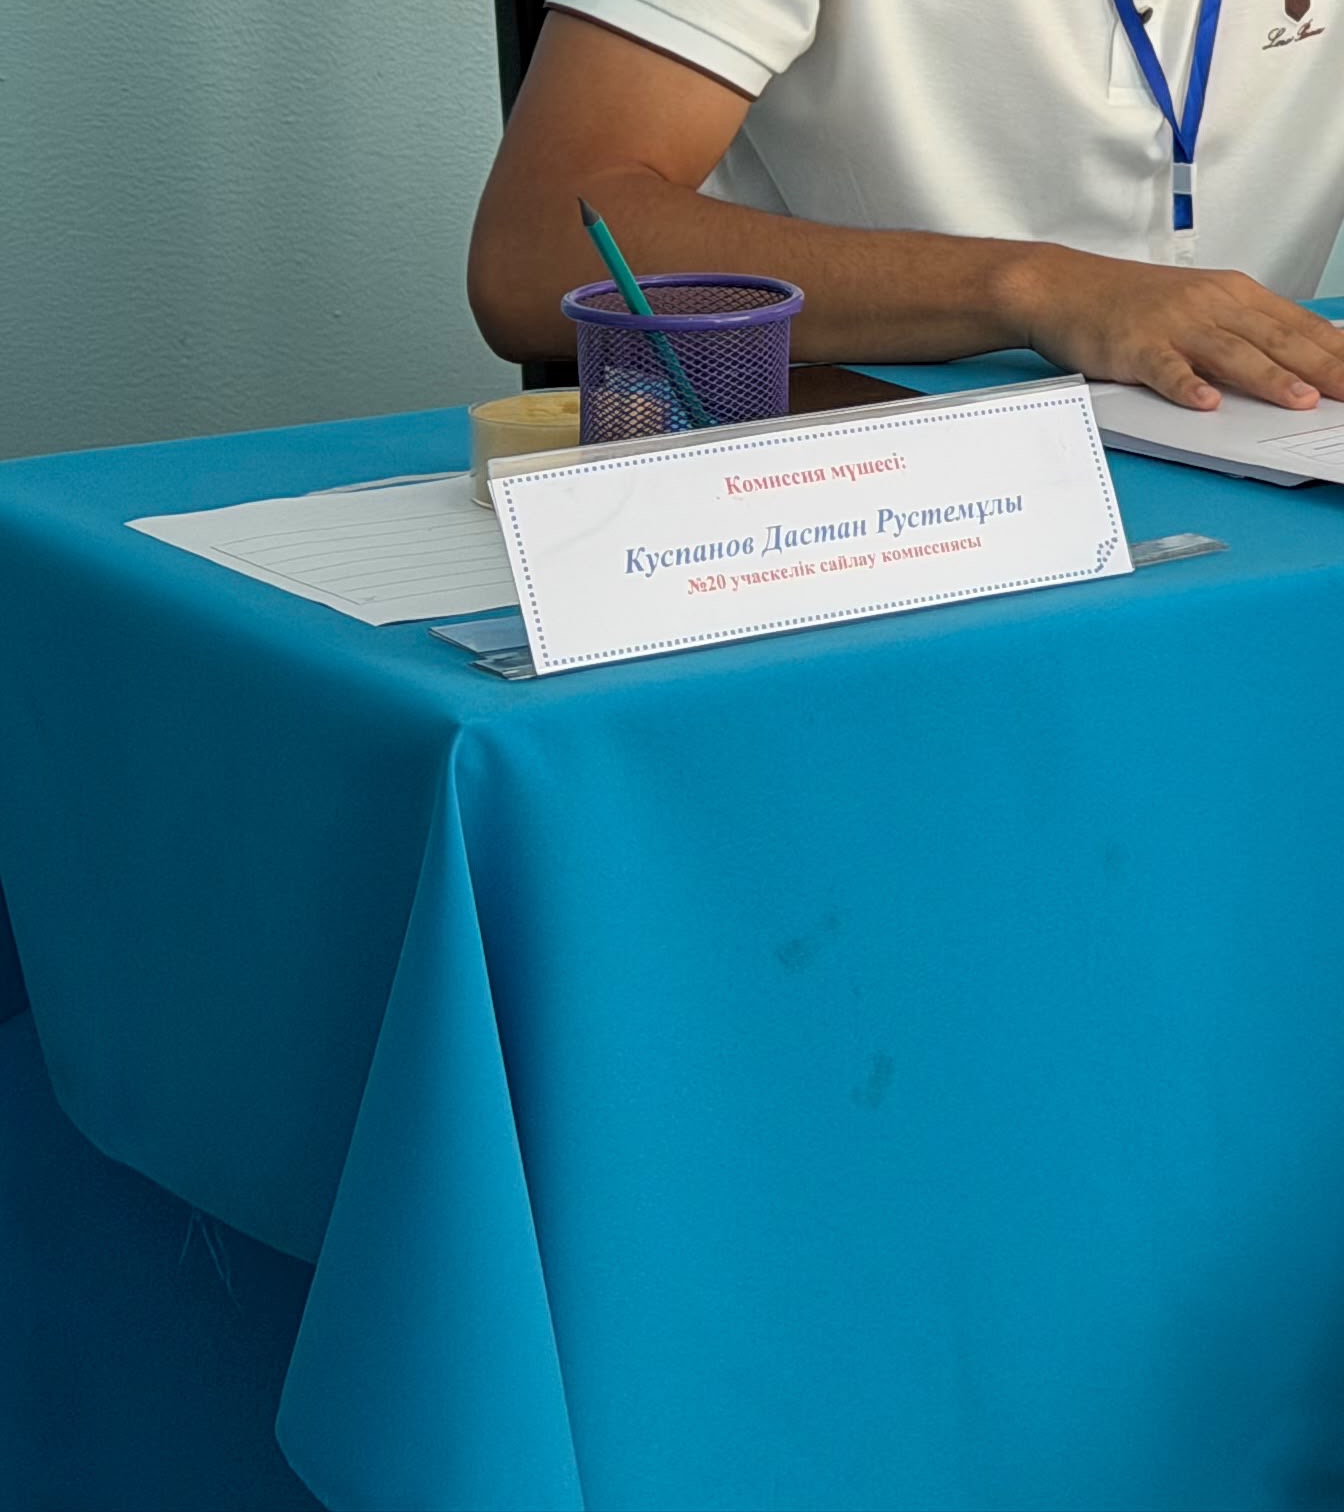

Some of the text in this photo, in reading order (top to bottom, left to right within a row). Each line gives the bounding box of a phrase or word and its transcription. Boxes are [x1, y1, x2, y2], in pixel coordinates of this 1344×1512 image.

[724, 452, 907, 495] Комиссия мүшесі:
[625, 494, 1024, 578] Куспанов Дастан Рустемұлы
[687, 536, 982, 595] №20 учаскелік сайлау комиссиясы
